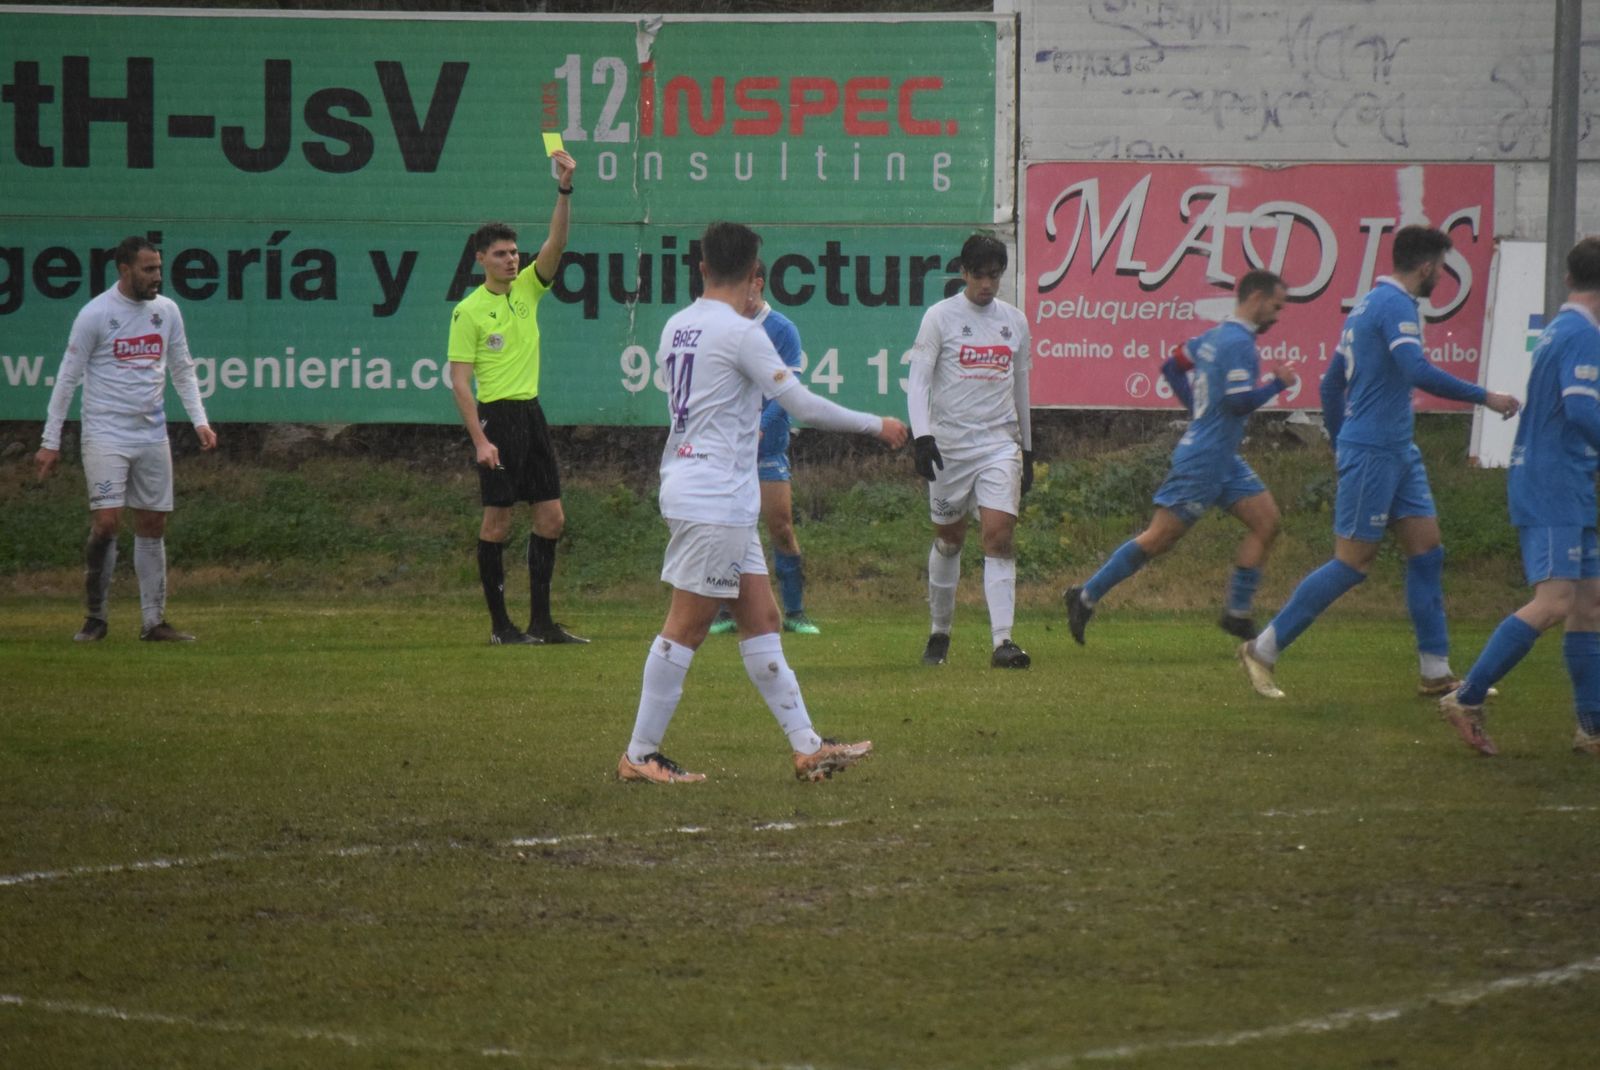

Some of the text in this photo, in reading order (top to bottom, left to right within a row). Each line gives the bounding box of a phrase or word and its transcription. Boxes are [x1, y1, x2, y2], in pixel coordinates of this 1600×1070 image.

[2, 55, 470, 173] tH-JsV
[554, 54, 630, 143] 12
[1038, 173, 1482, 323] MADIS
[369, 250, 418, 317] y
[1036, 295, 1194, 325] peluquería
[116, 338, 161, 356] Dulca
[962, 347, 1010, 365] Dulca
[1036, 338, 1113, 359] Camino
[1123, 340, 1150, 359] de
